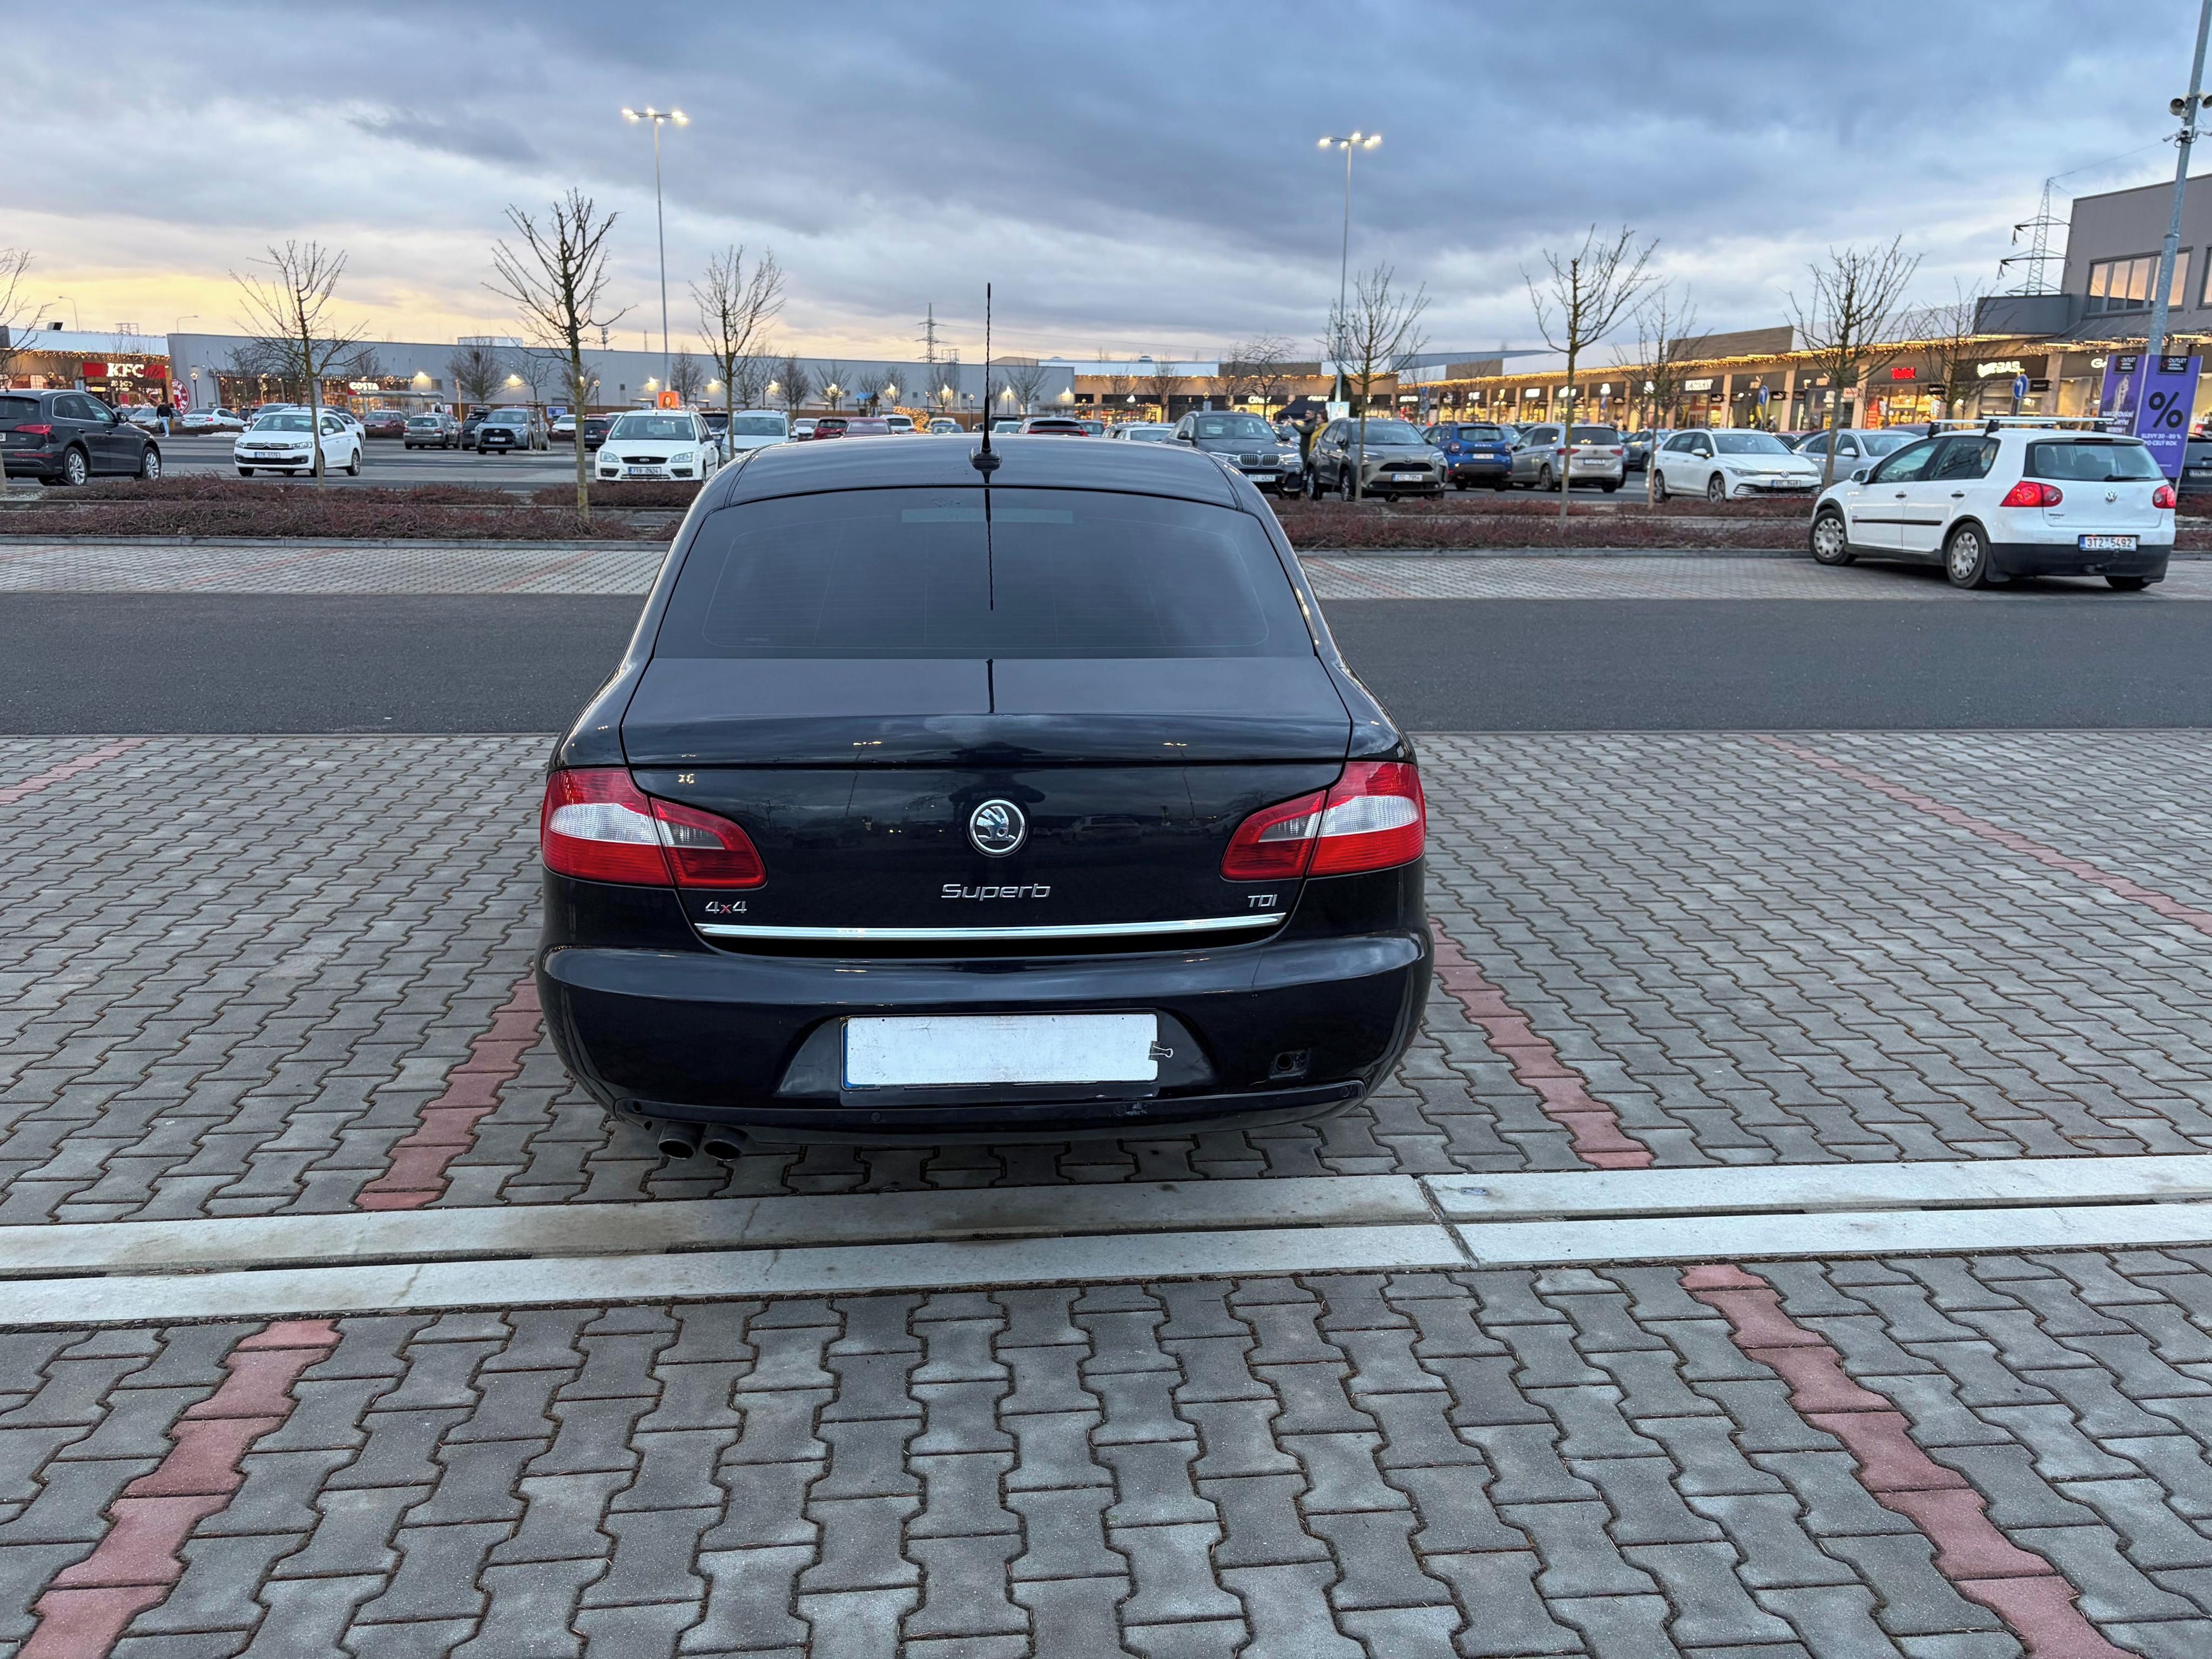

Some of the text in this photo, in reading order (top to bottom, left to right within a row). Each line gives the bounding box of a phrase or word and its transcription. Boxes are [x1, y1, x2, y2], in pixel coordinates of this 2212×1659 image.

[106, 363, 144, 377] KFC
[349, 382, 379, 390] COSTA
[2087, 538, 2133, 548] 3T2 5492
[941, 884, 1051, 901] Superb
[1247, 894, 1278, 907] TDI
[705, 901, 747, 914] 4x4
